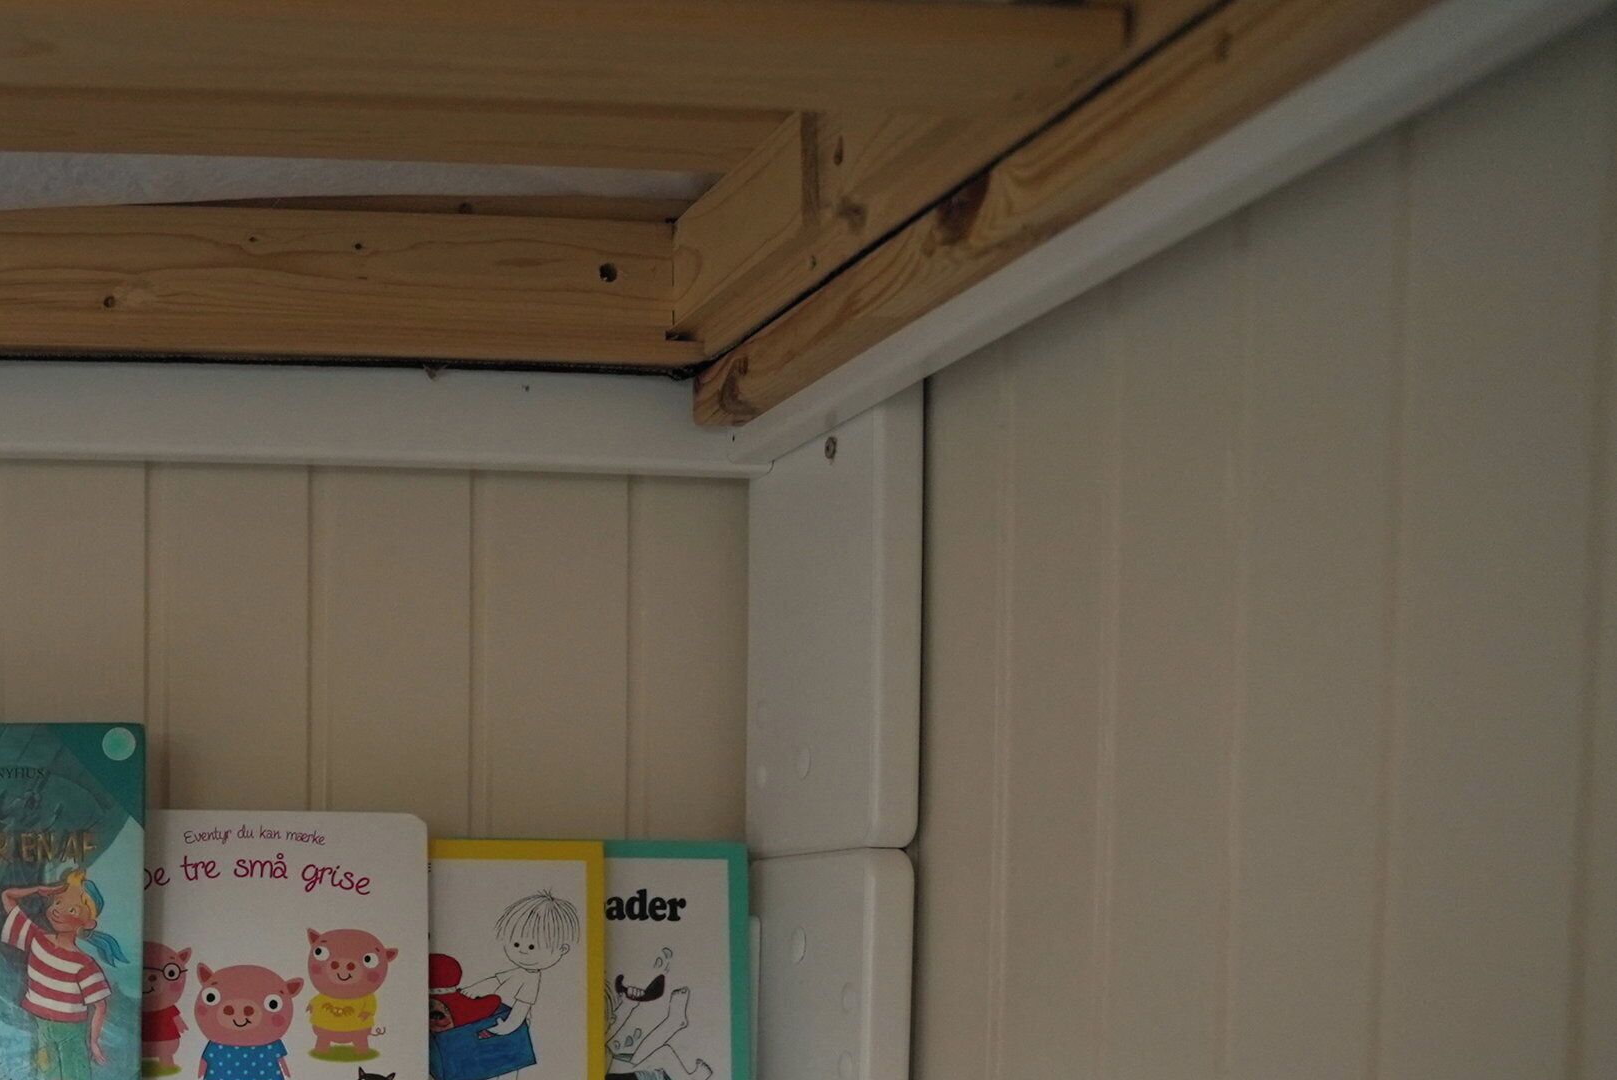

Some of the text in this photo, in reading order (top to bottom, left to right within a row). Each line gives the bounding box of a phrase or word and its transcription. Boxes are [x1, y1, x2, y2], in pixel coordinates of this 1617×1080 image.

[20, 830, 56, 863] EN
[61, 830, 98, 863] AF
[183, 824, 327, 846] Eventyr du kan mærke
[179, 855, 221, 882] tre
[232, 852, 288, 879] små
[301, 863, 371, 896] grise
[604, 888, 687, 922] ader
